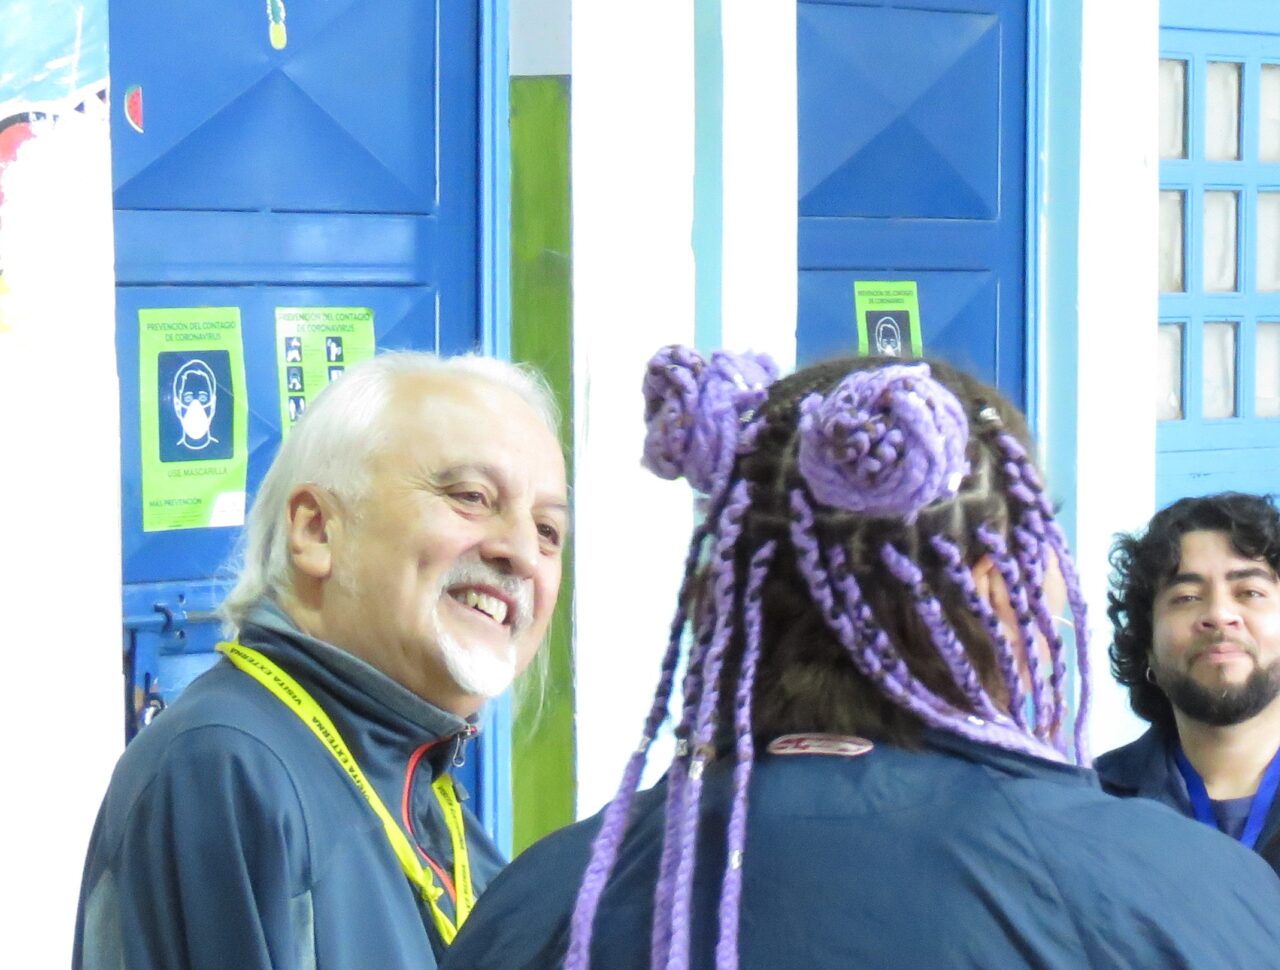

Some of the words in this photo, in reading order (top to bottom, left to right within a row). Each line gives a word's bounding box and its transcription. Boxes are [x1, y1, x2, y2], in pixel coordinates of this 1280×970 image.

[189, 322, 202, 330] DEL
[202, 321, 236, 330] CONTAGIO
[336, 312, 371, 321] CONTAGIO
[175, 333, 221, 341] CORONAVIRUS
[229, 647, 273, 676] EXTERNA
[273, 675, 302, 706] VISITA
[312, 716, 349, 765] EXTERNA
